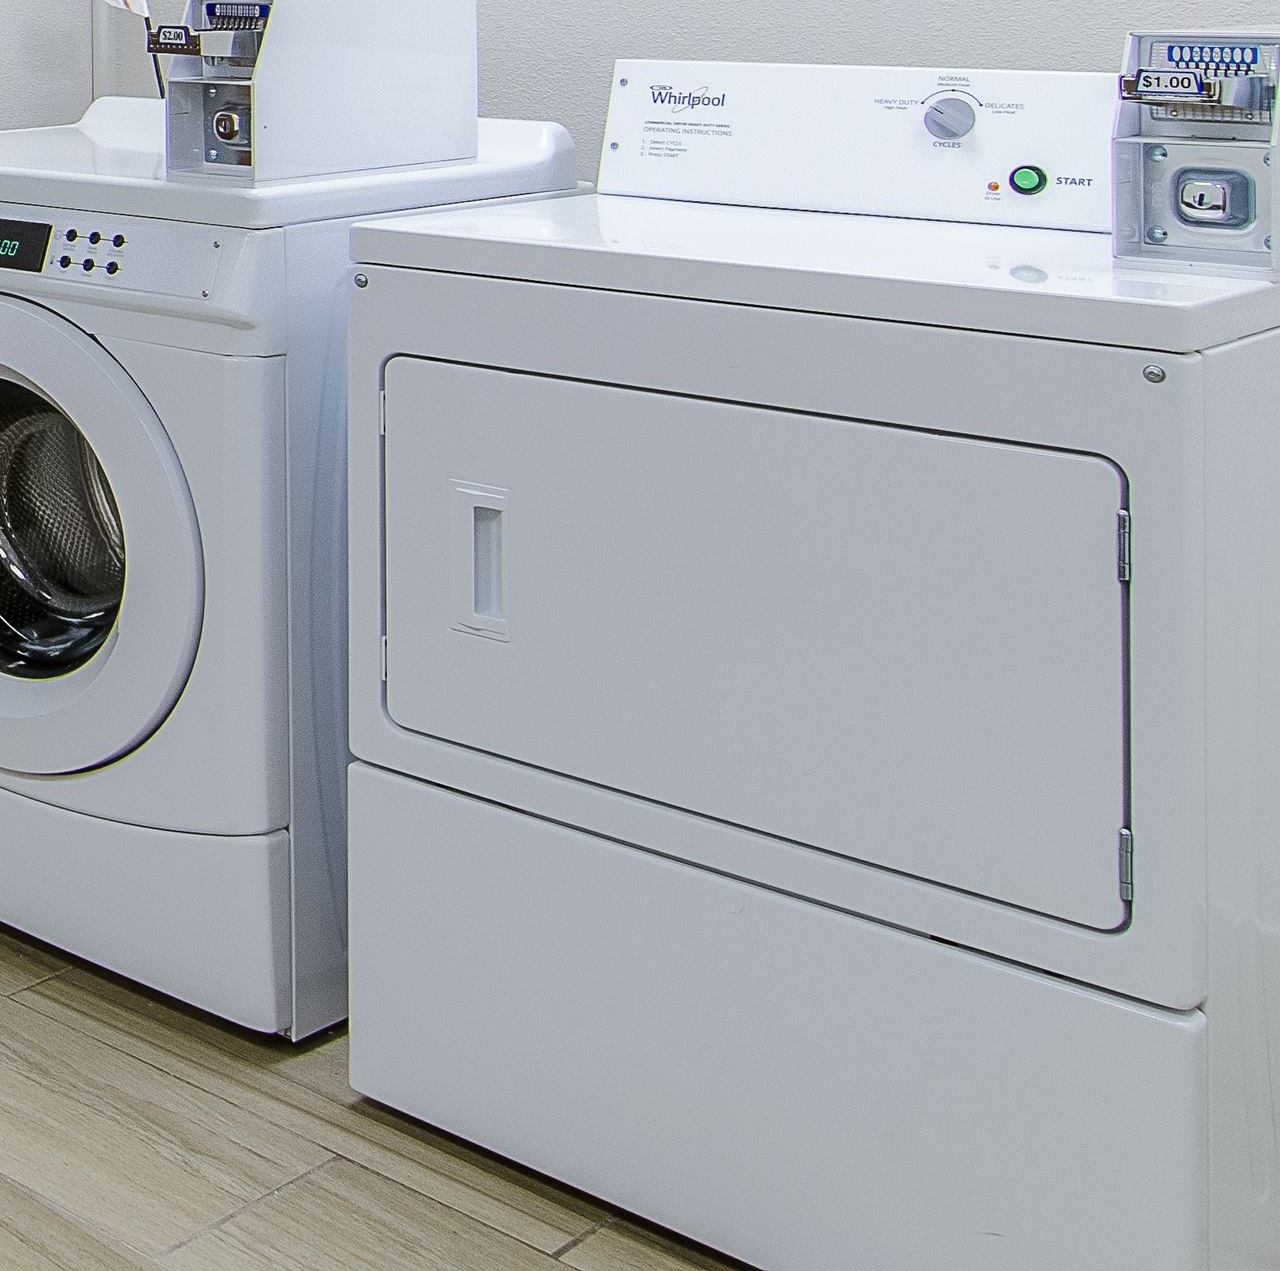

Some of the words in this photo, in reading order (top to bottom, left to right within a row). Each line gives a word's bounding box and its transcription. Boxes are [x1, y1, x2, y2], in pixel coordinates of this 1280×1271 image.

[162, 30, 183, 42] $2.00
[938, 75, 970, 83] NORMAL
[1142, 75, 1191, 89] $1.00
[651, 90, 726, 109] Whirlpool
[985, 102, 1024, 110] DELICATES
[643, 126, 681, 134] OPERATING
[682, 128, 732, 136] INSTRUCTIONS
[932, 141, 961, 149] CYCLES
[1056, 176, 1094, 187] START
